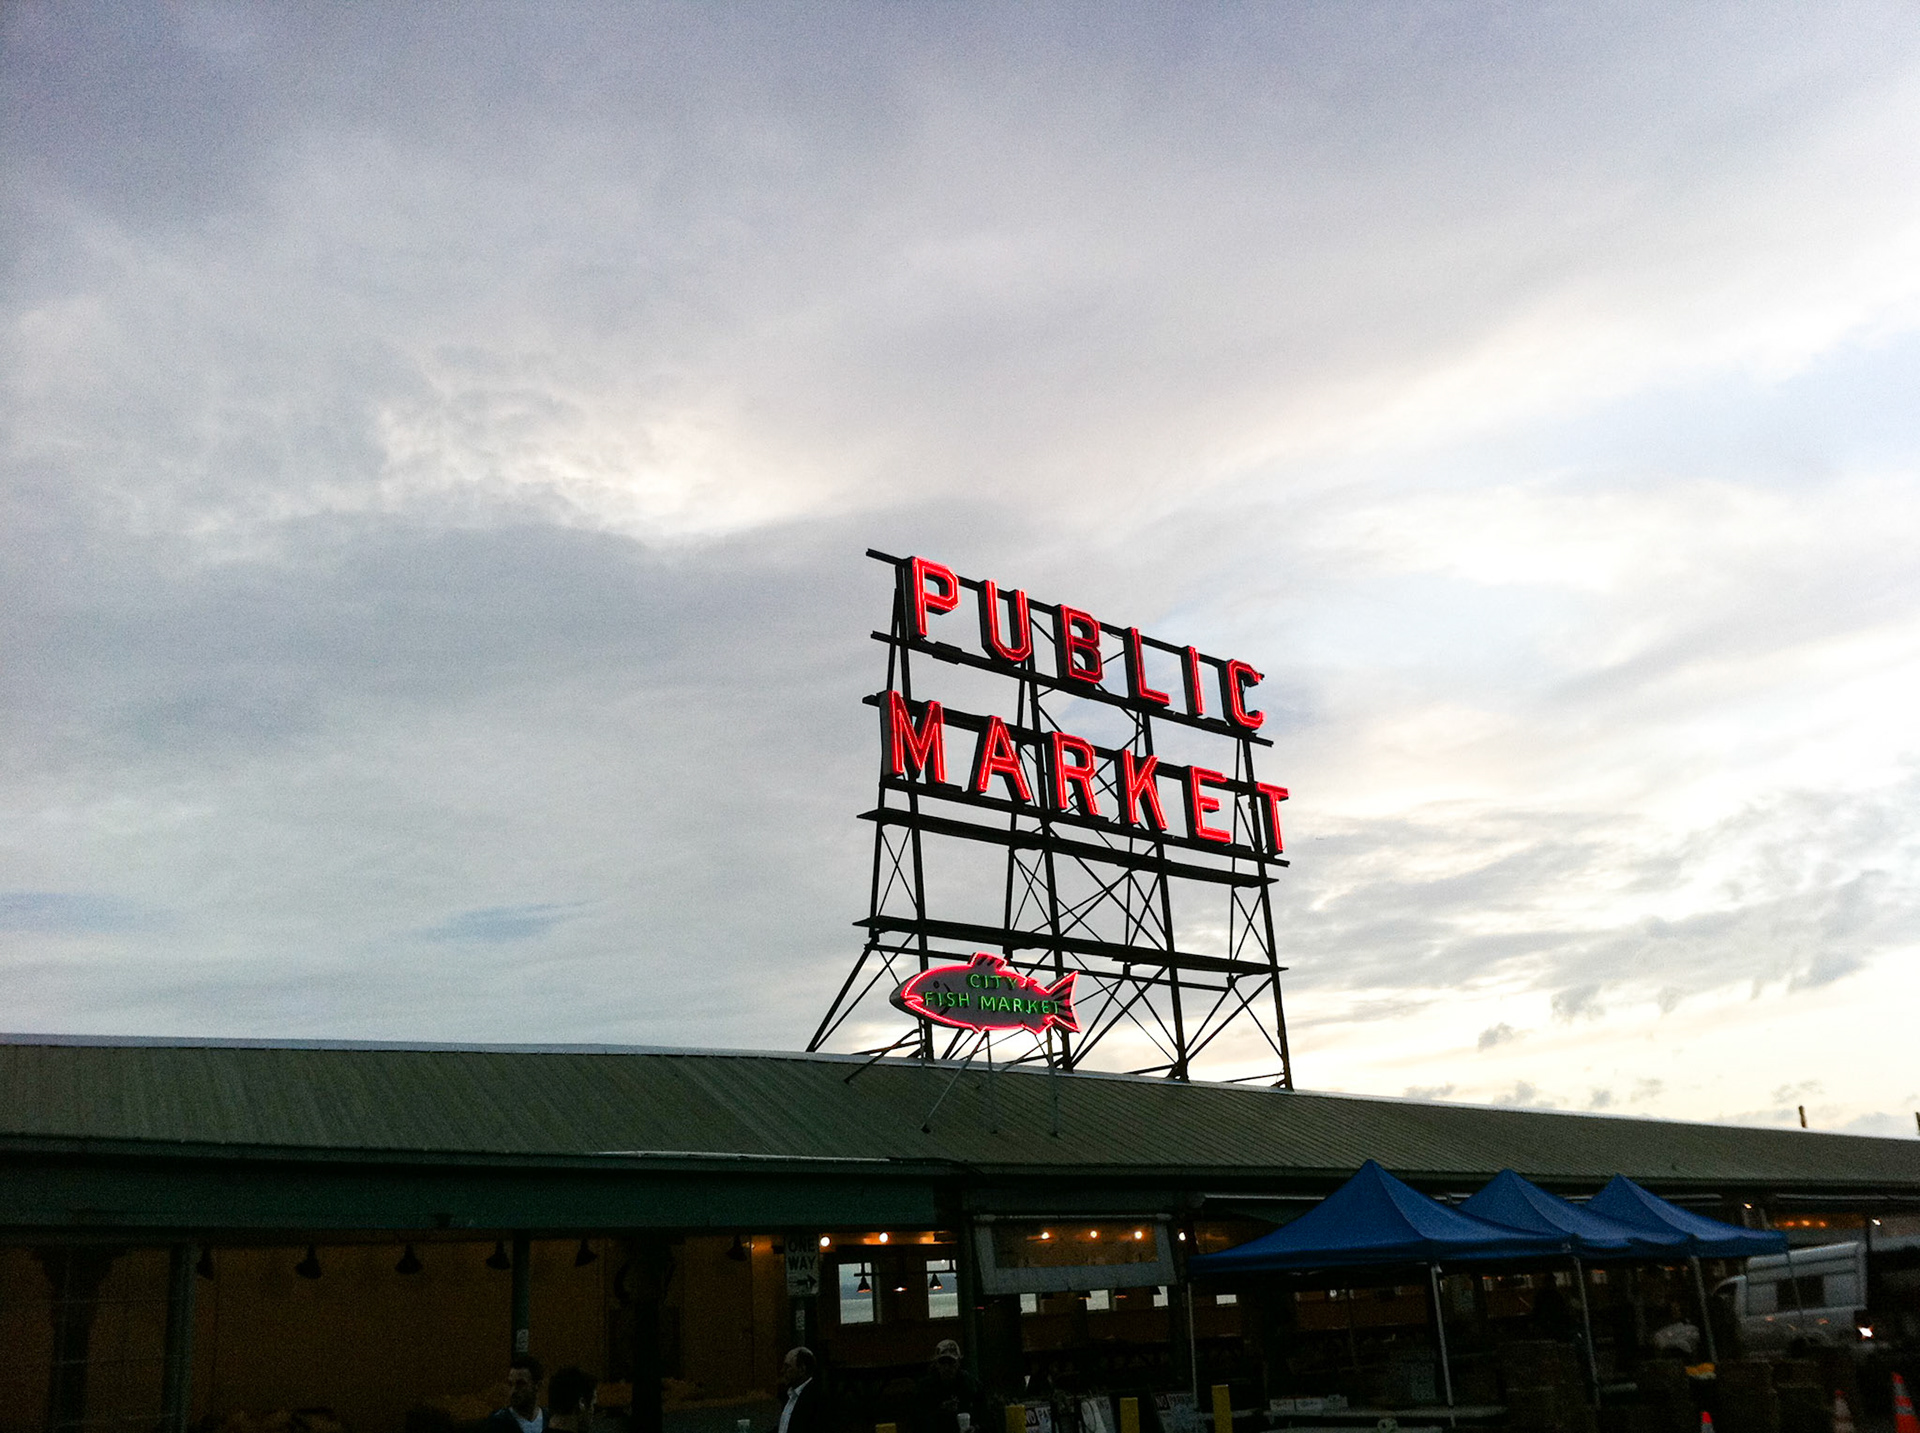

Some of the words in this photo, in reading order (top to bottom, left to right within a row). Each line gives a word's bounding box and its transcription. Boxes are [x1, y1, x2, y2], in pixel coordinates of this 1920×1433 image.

[908, 556, 1266, 729] PUBLIC
[884, 690, 1290, 854] MARKET
[969, 973, 1018, 989] CITY
[924, 991, 970, 1007] FISH
[980, 995, 1060, 1014] MARKET
[787, 1239, 816, 1253] ONE
[787, 1255, 816, 1271] WAY
